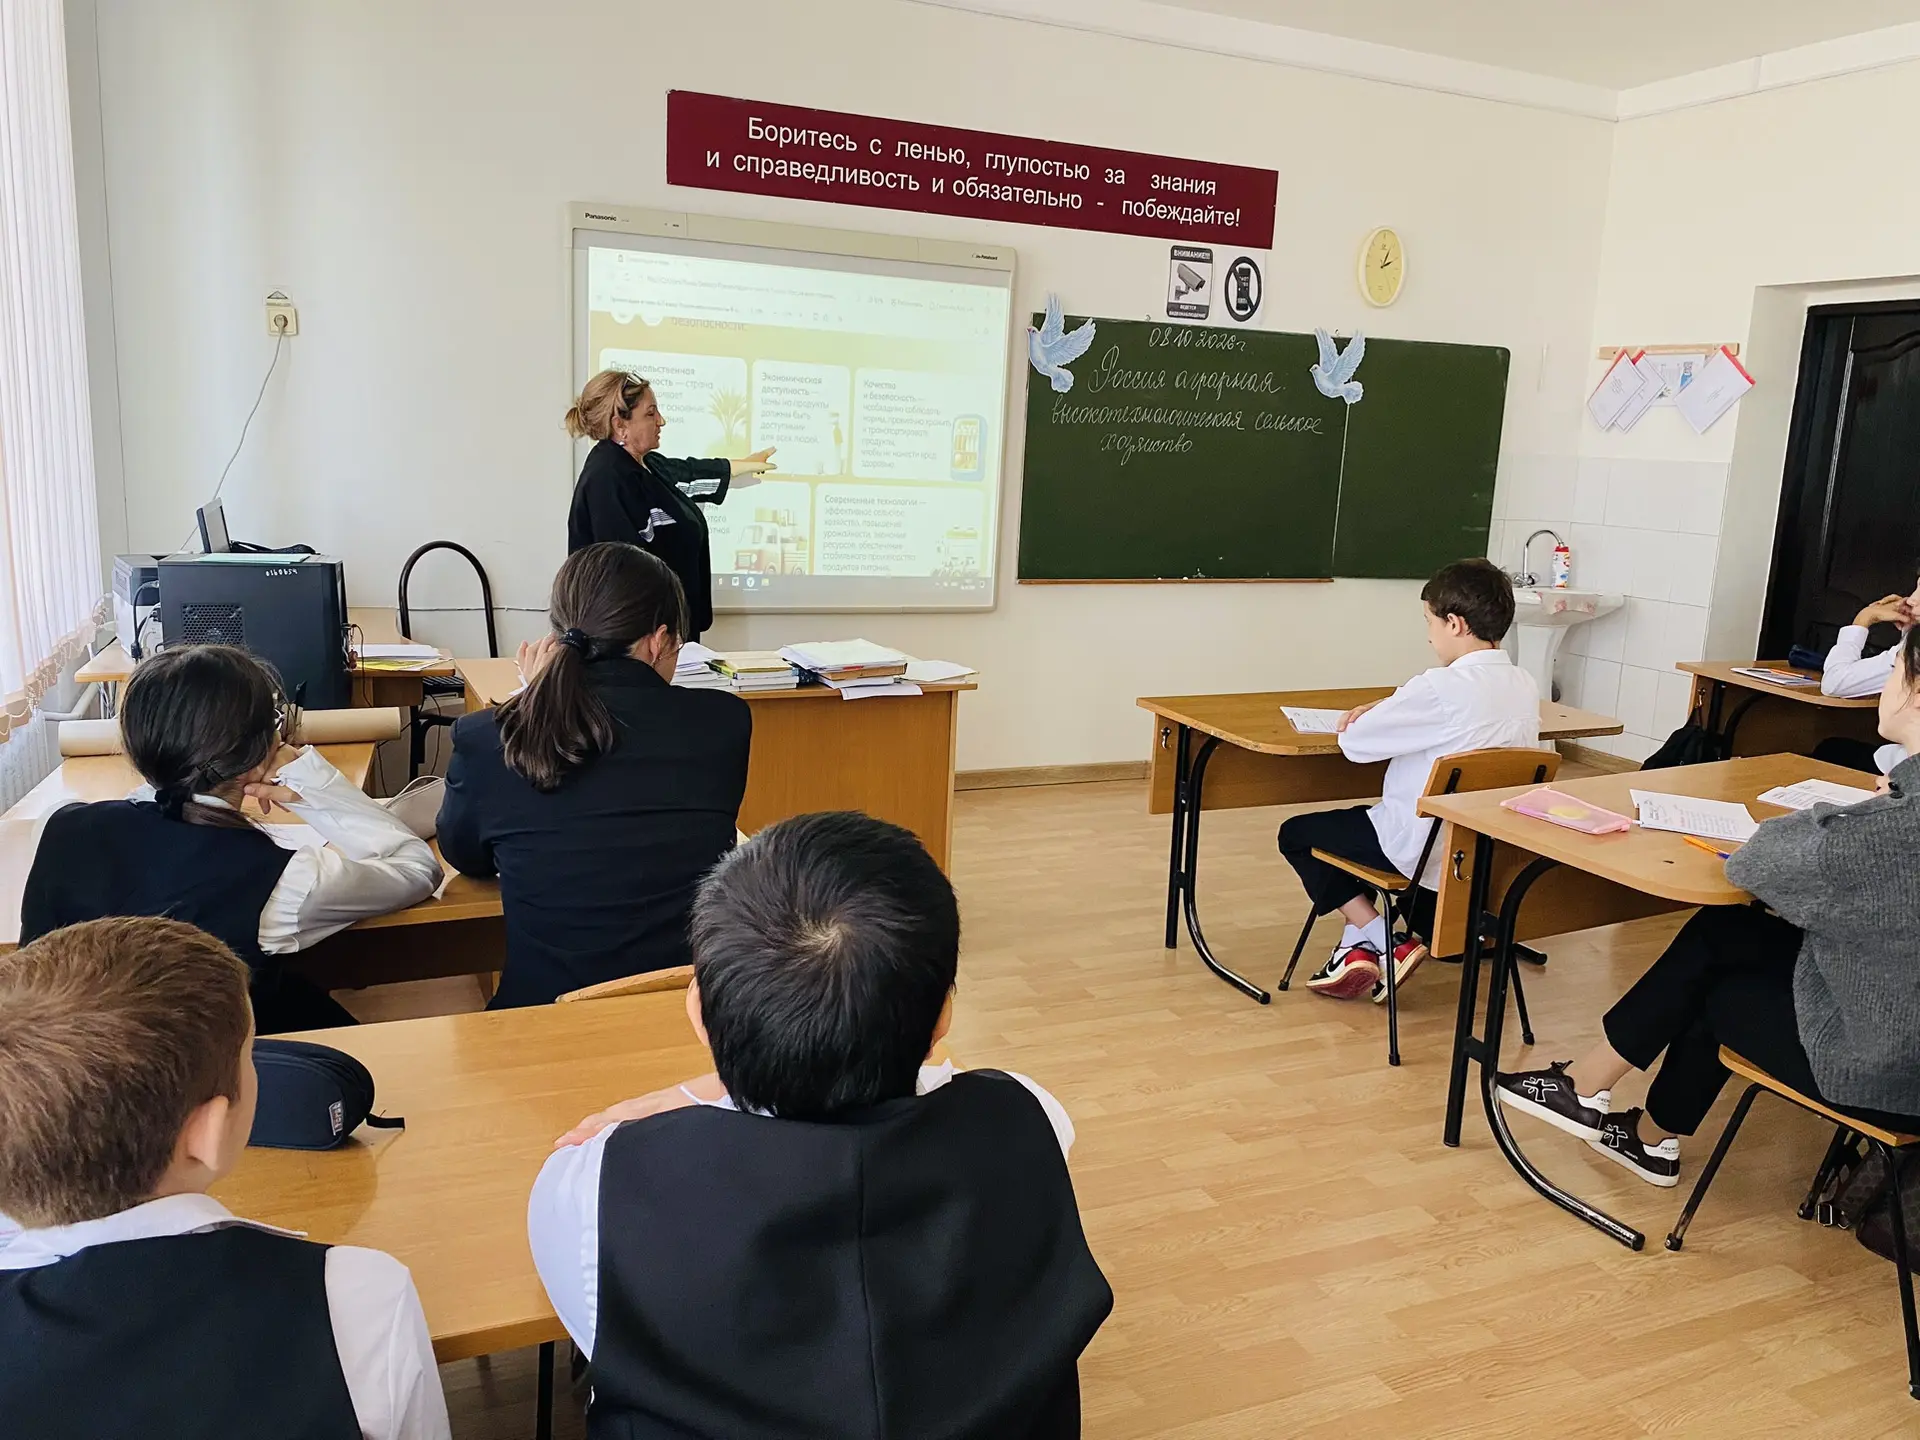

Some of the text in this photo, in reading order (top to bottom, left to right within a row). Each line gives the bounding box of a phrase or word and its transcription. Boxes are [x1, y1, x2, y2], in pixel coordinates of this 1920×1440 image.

[748, 116, 1217, 195] Боритесь с ленью, глупостью за знания
[706, 151, 720, 168] и
[733, 154, 920, 192] справедливость
[932, 177, 944, 194] и
[953, 176, 1082, 209] обязательно
[1122, 197, 1241, 228] побеждайте!
[584, 212, 617, 221] Panasonic
[761, 372, 823, 385] Экономическая
[1087, 344, 1166, 393] Россия
[824, 494, 875, 506] Современные
